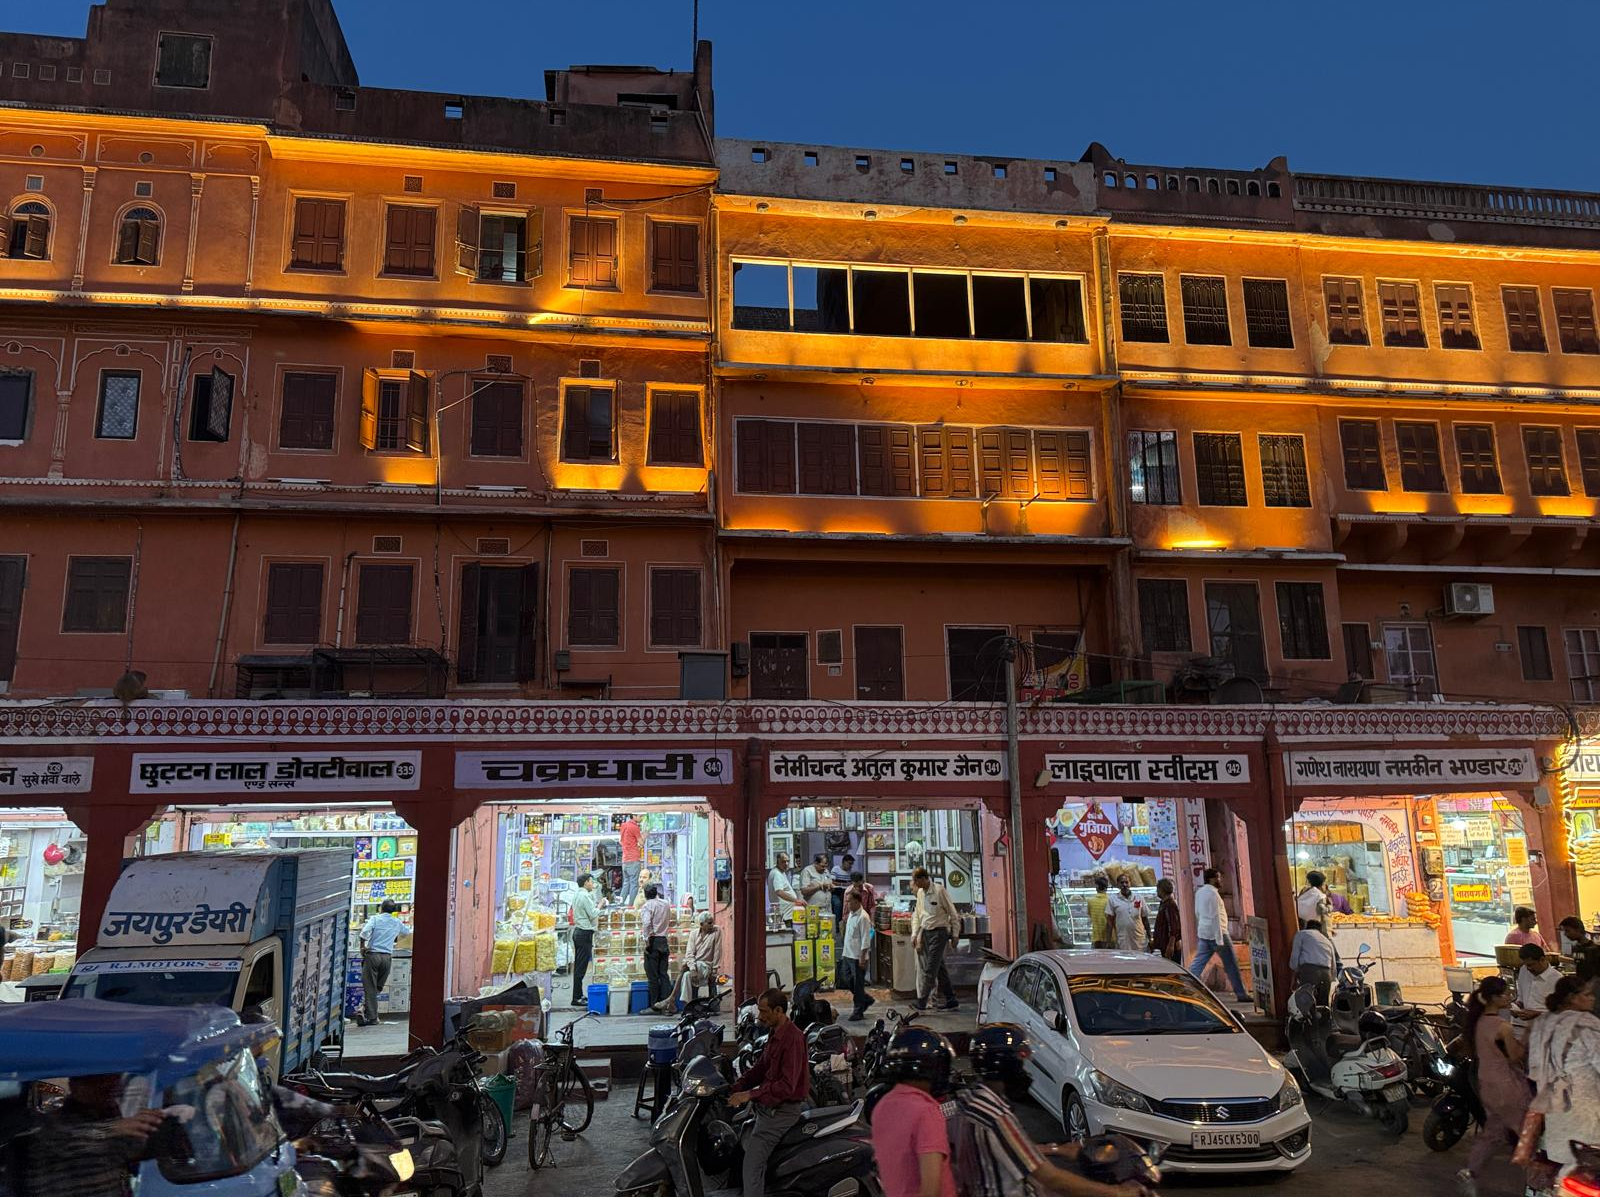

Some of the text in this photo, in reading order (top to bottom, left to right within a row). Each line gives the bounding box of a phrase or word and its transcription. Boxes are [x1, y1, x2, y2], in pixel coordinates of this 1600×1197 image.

[216, 762, 269, 780] लाल
[397, 764, 414, 777] 339
[705, 760, 722, 774] 340
[774, 754, 1000, 781] नेमीचन्द अतुल कुमार जैन 341
[1147, 755, 1219, 782] स्वीट्स
[1226, 762, 1241, 775] 342
[1295, 756, 1332, 777] गणेश
[1333, 760, 1380, 777] नारायण
[1384, 754, 1443, 777] नमकीन
[1448, 759, 1509, 775] भण्डार
[41, 773, 60, 785] मेवा
[61, 772, 82, 785] वाले
[268, 780, 296, 789] सन्स
[1079, 820, 1113, 837] गुजिया
[103, 901, 251, 944] जयपुर डेयरी
[1200, 1133, 1259, 1146] RJ45CK5300
